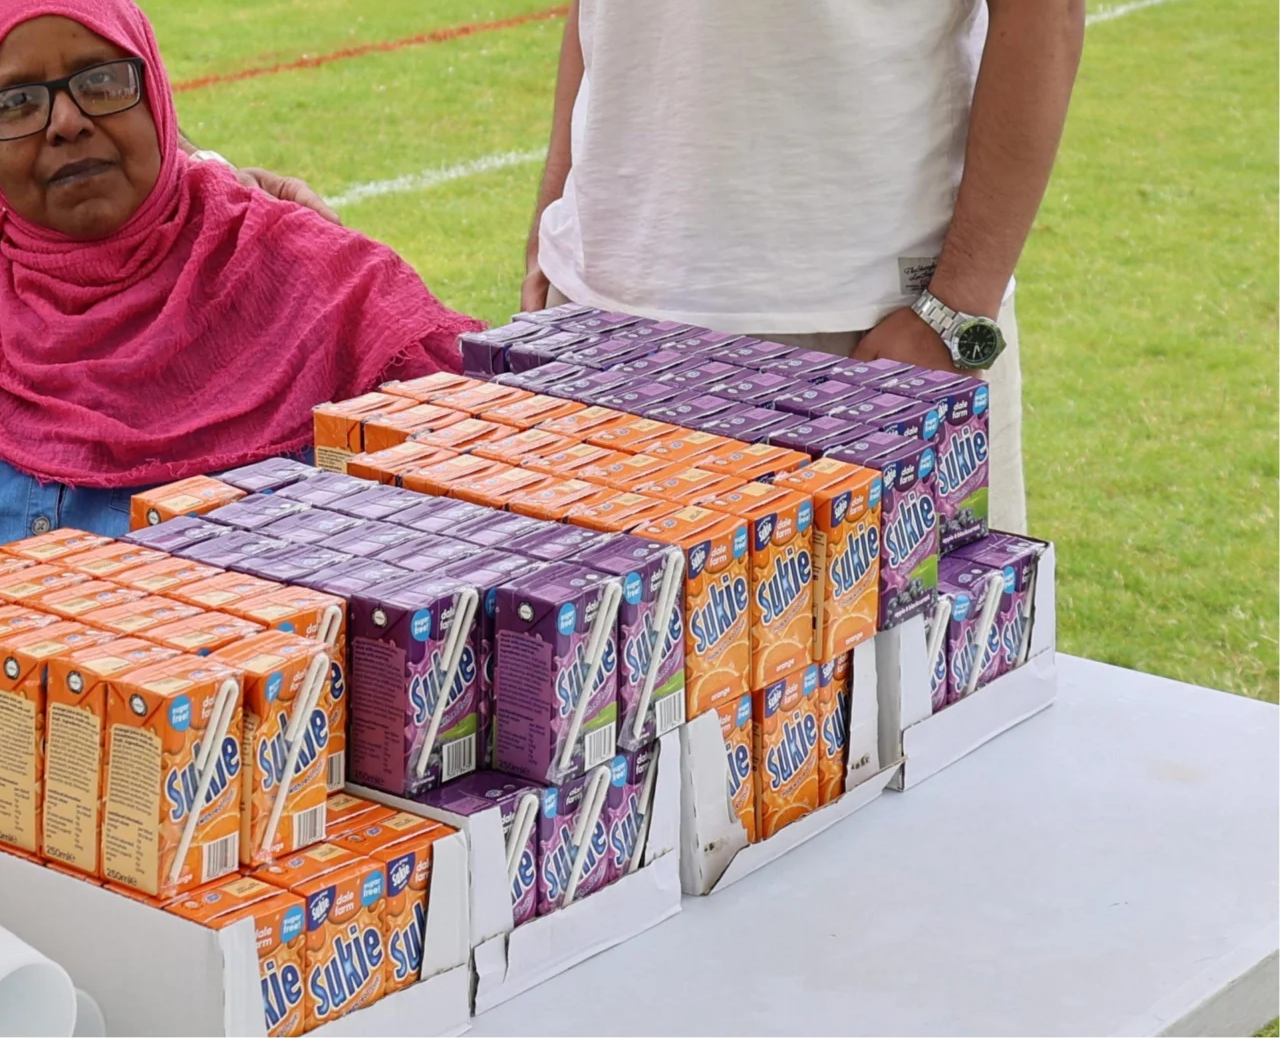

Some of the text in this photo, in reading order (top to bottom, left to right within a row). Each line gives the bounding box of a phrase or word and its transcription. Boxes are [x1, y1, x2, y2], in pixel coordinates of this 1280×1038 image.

[953, 399, 968, 411] dale
[952, 408, 968, 420] farm
[901, 464, 915, 477] dale
[900, 473, 914, 486] farm
[776, 517, 792, 530] dale
[776, 527, 792, 540] farm
[711, 544, 726, 557] dale
[710, 554, 726, 567] farm
[336, 890, 355, 905] dale
[335, 902, 355, 918] farm
